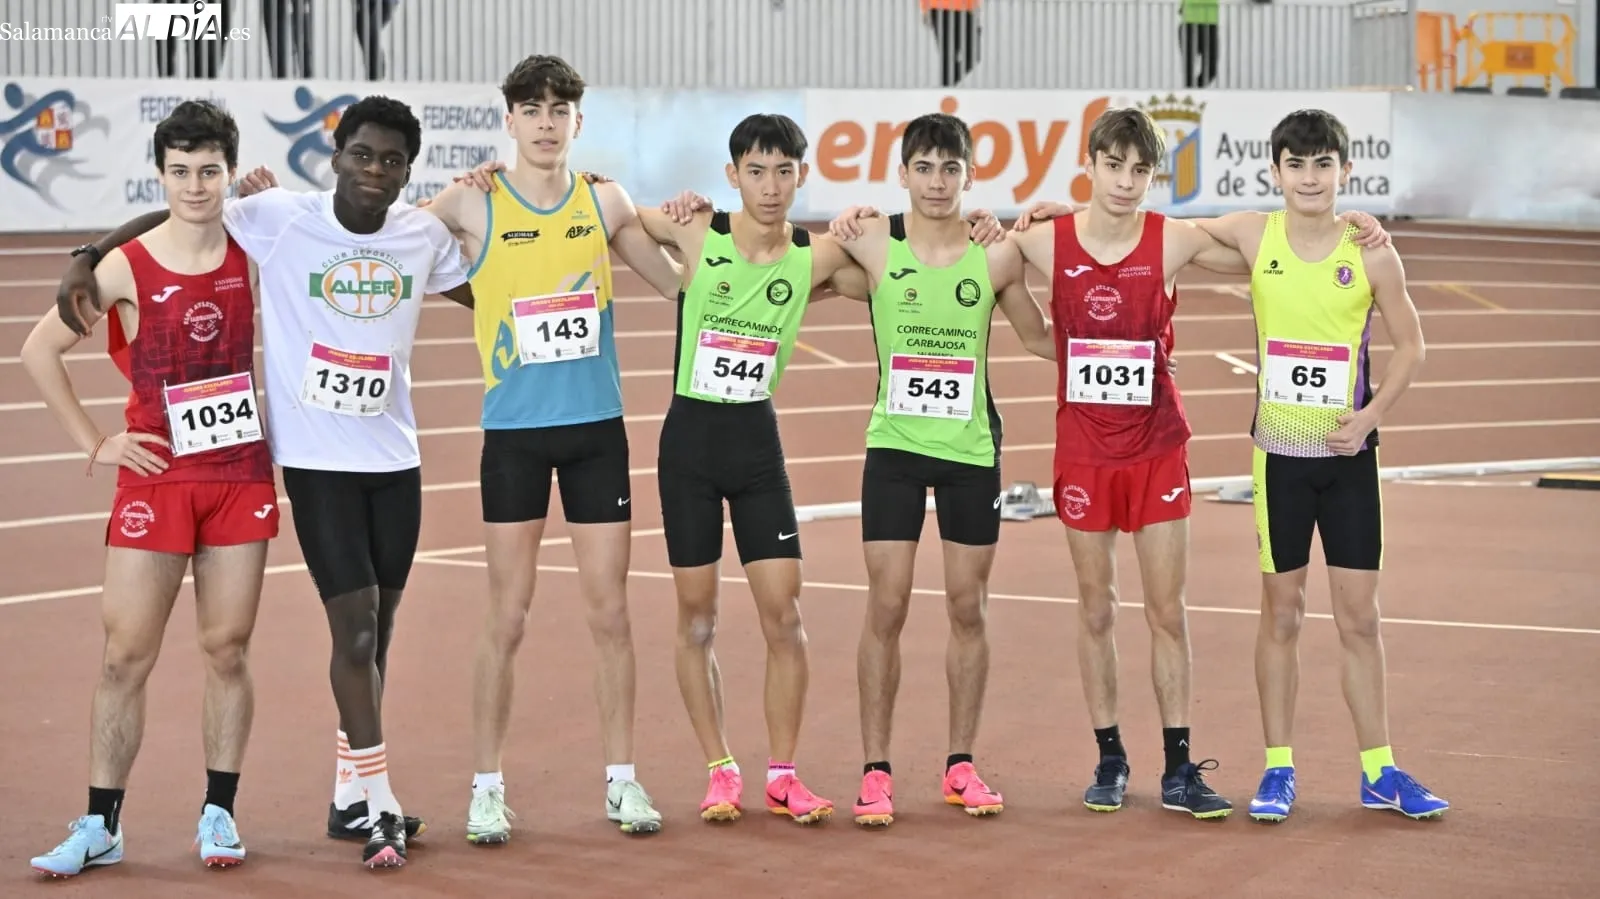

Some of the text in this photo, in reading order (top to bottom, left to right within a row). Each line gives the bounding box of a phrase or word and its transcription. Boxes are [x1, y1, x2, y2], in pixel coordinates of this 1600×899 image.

[1216, 170, 1245, 197] de
[321, 251, 348, 269] CLUB
[329, 279, 397, 298] ALCER
[536, 316, 589, 343] 143
[703, 313, 784, 335] CORRECAMINOS
[896, 324, 977, 339] CORRECAMINOS
[906, 338, 966, 351] CARBAJOSA
[712, 355, 764, 382] 544
[1078, 364, 1145, 387] 1031
[1291, 365, 1327, 388] 65
[316, 368, 386, 399] 1310
[907, 376, 960, 400] 543
[181, 397, 254, 431] 1034
